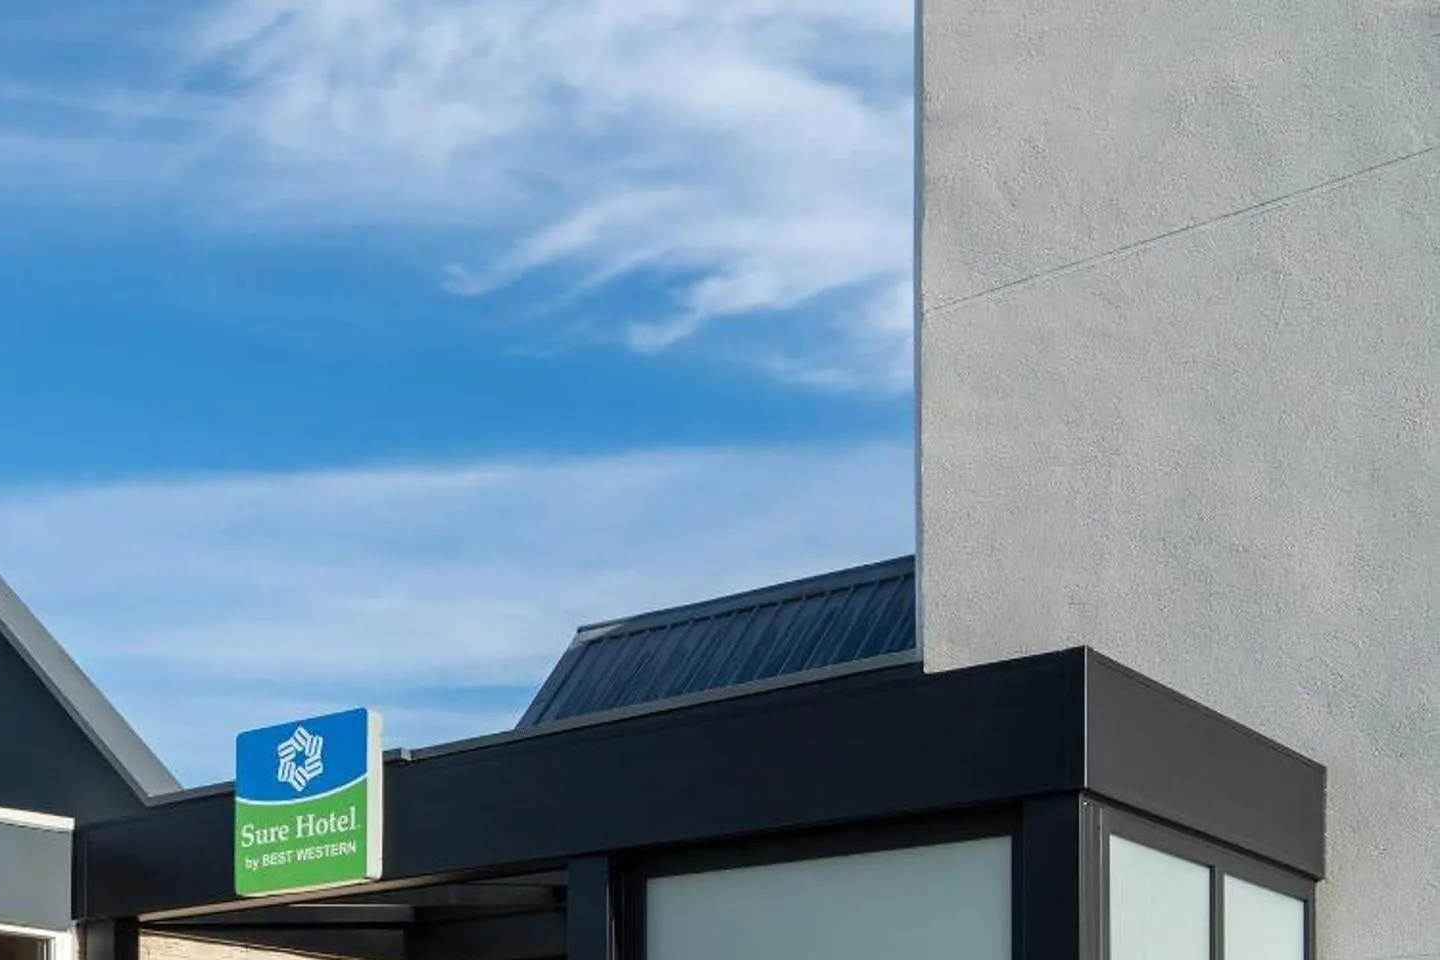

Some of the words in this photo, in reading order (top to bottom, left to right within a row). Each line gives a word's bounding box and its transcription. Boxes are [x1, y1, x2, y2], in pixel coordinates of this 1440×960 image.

[241, 823, 289, 848] Sure
[296, 806, 356, 838] Hotel
[245, 856, 260, 871] by
[262, 850, 293, 867] BEST
[296, 840, 357, 861] WESTERN
